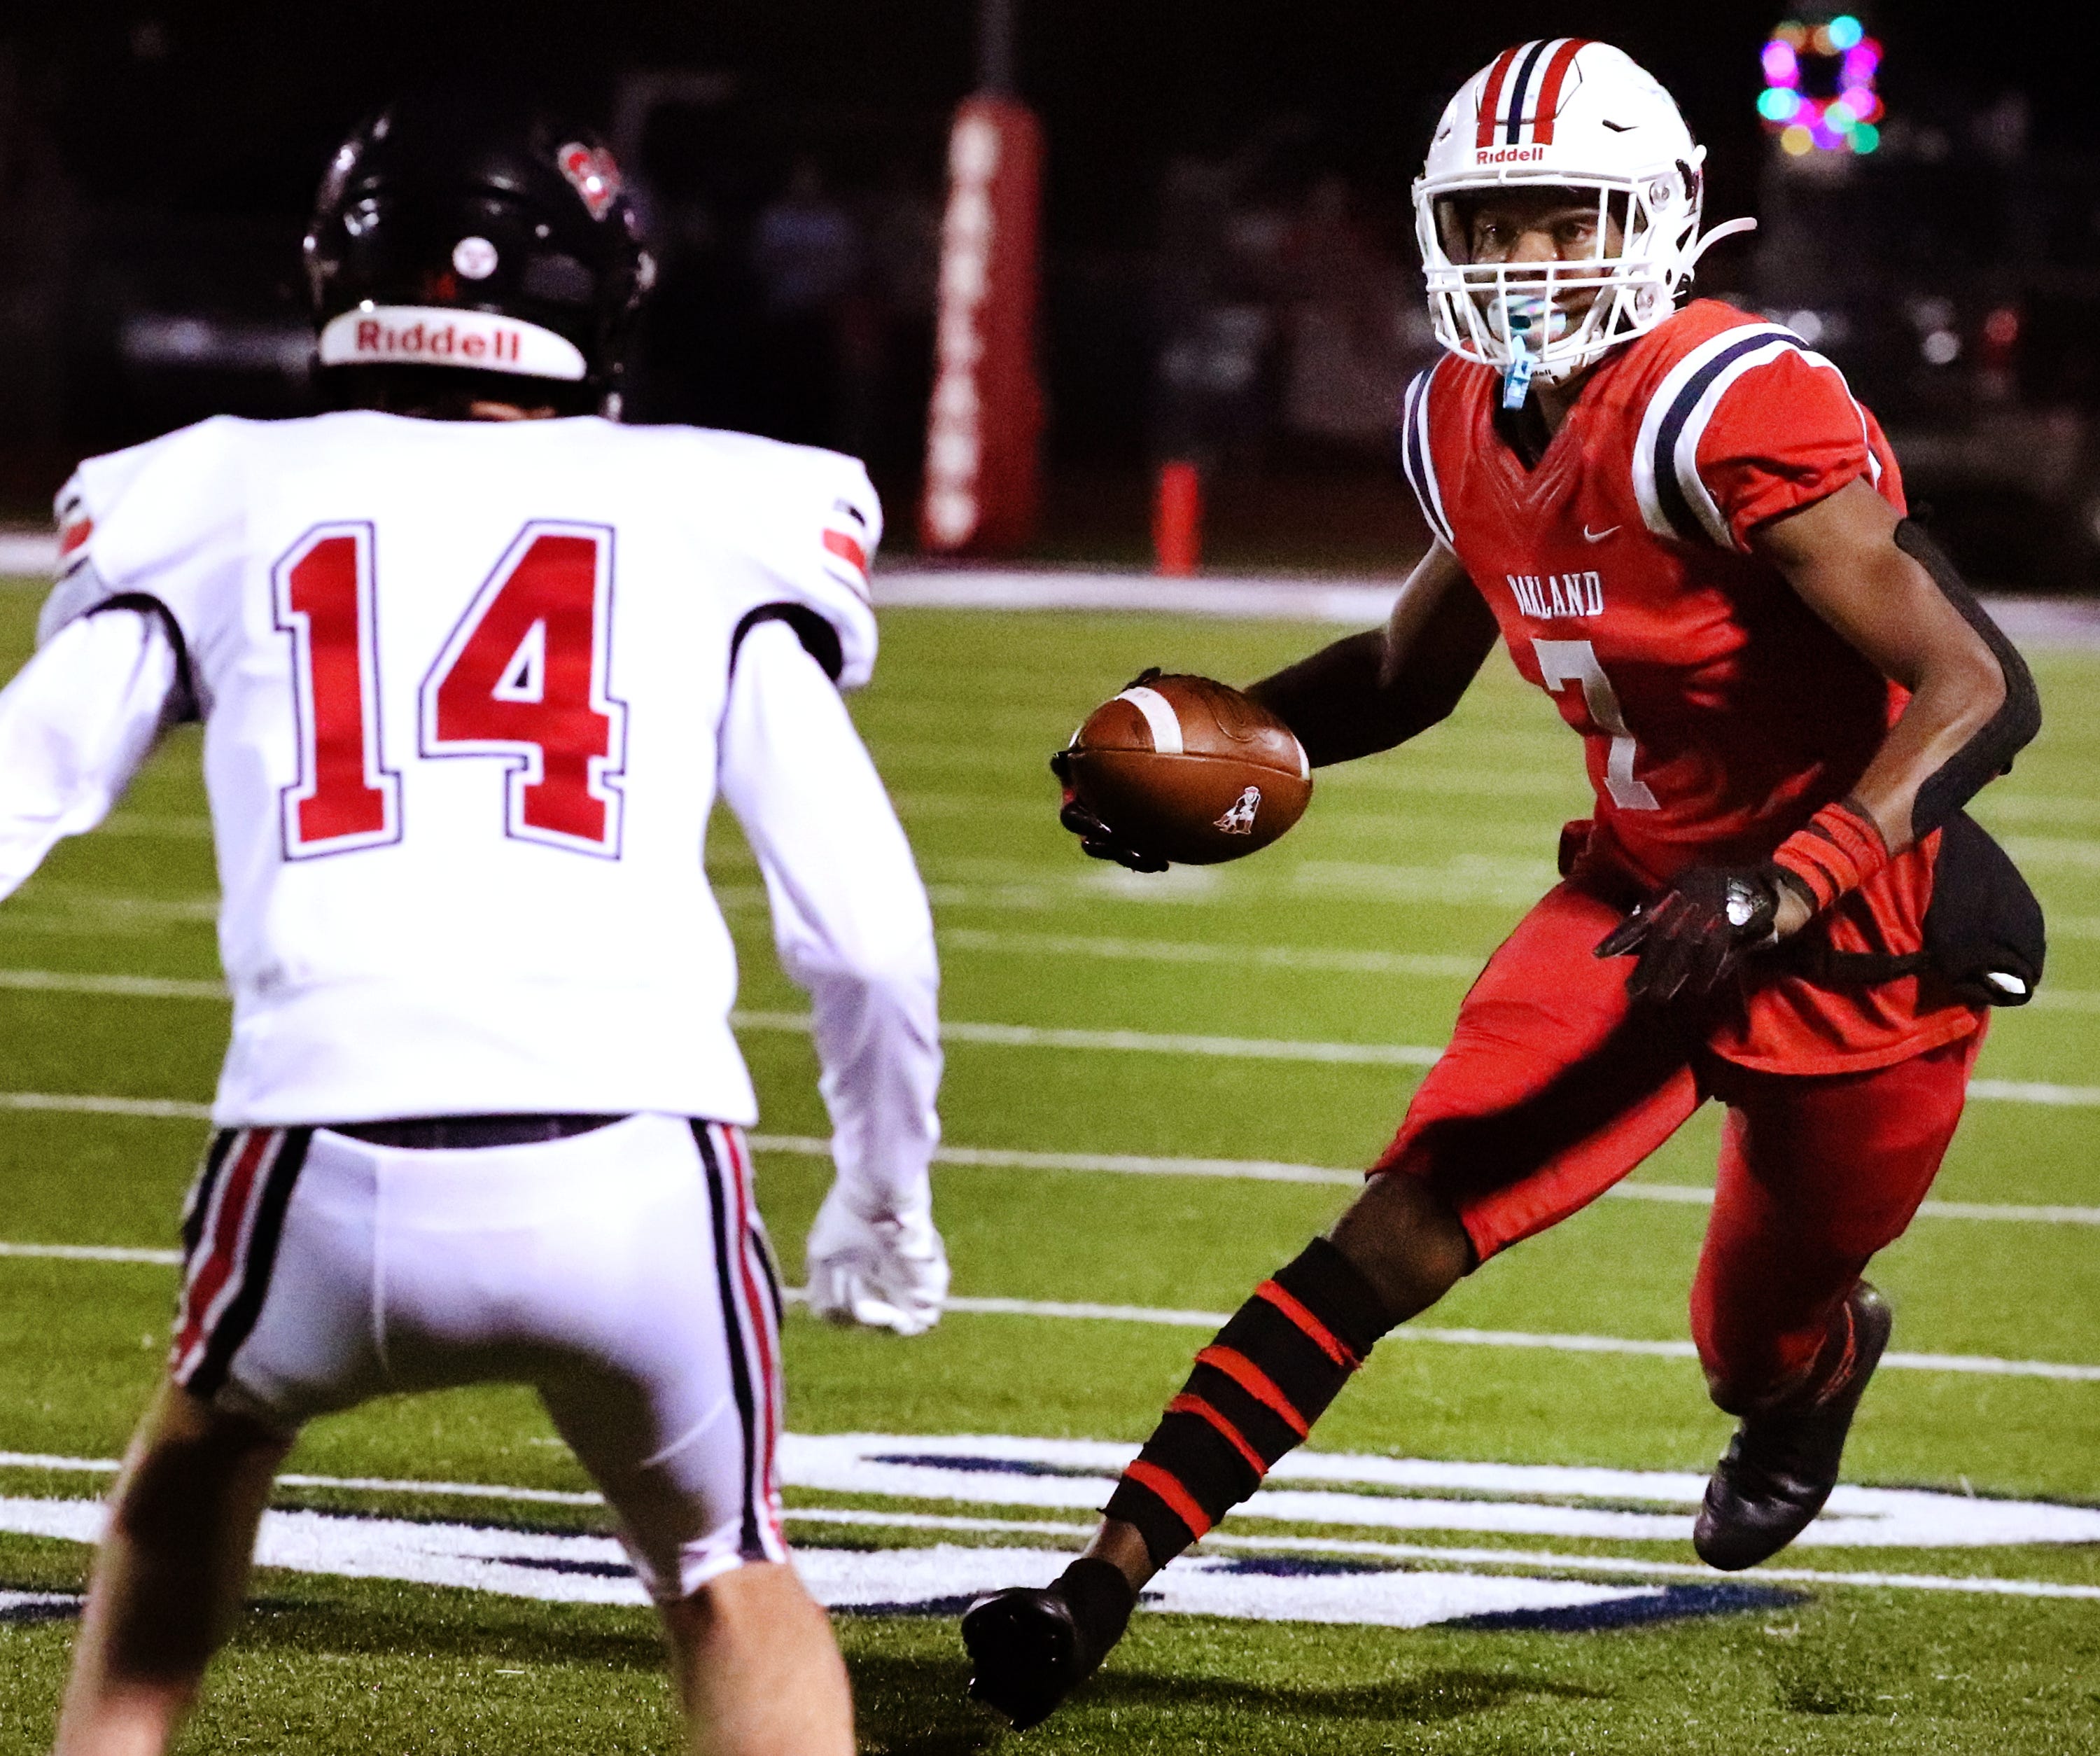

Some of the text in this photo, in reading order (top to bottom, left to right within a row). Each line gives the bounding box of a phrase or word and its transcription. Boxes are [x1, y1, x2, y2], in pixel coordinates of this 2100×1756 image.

[1476, 147, 1544, 165] Riddell
[355, 319, 522, 363] Riddell
[270, 519, 629, 863] 14
[1530, 637, 1661, 811] 7
